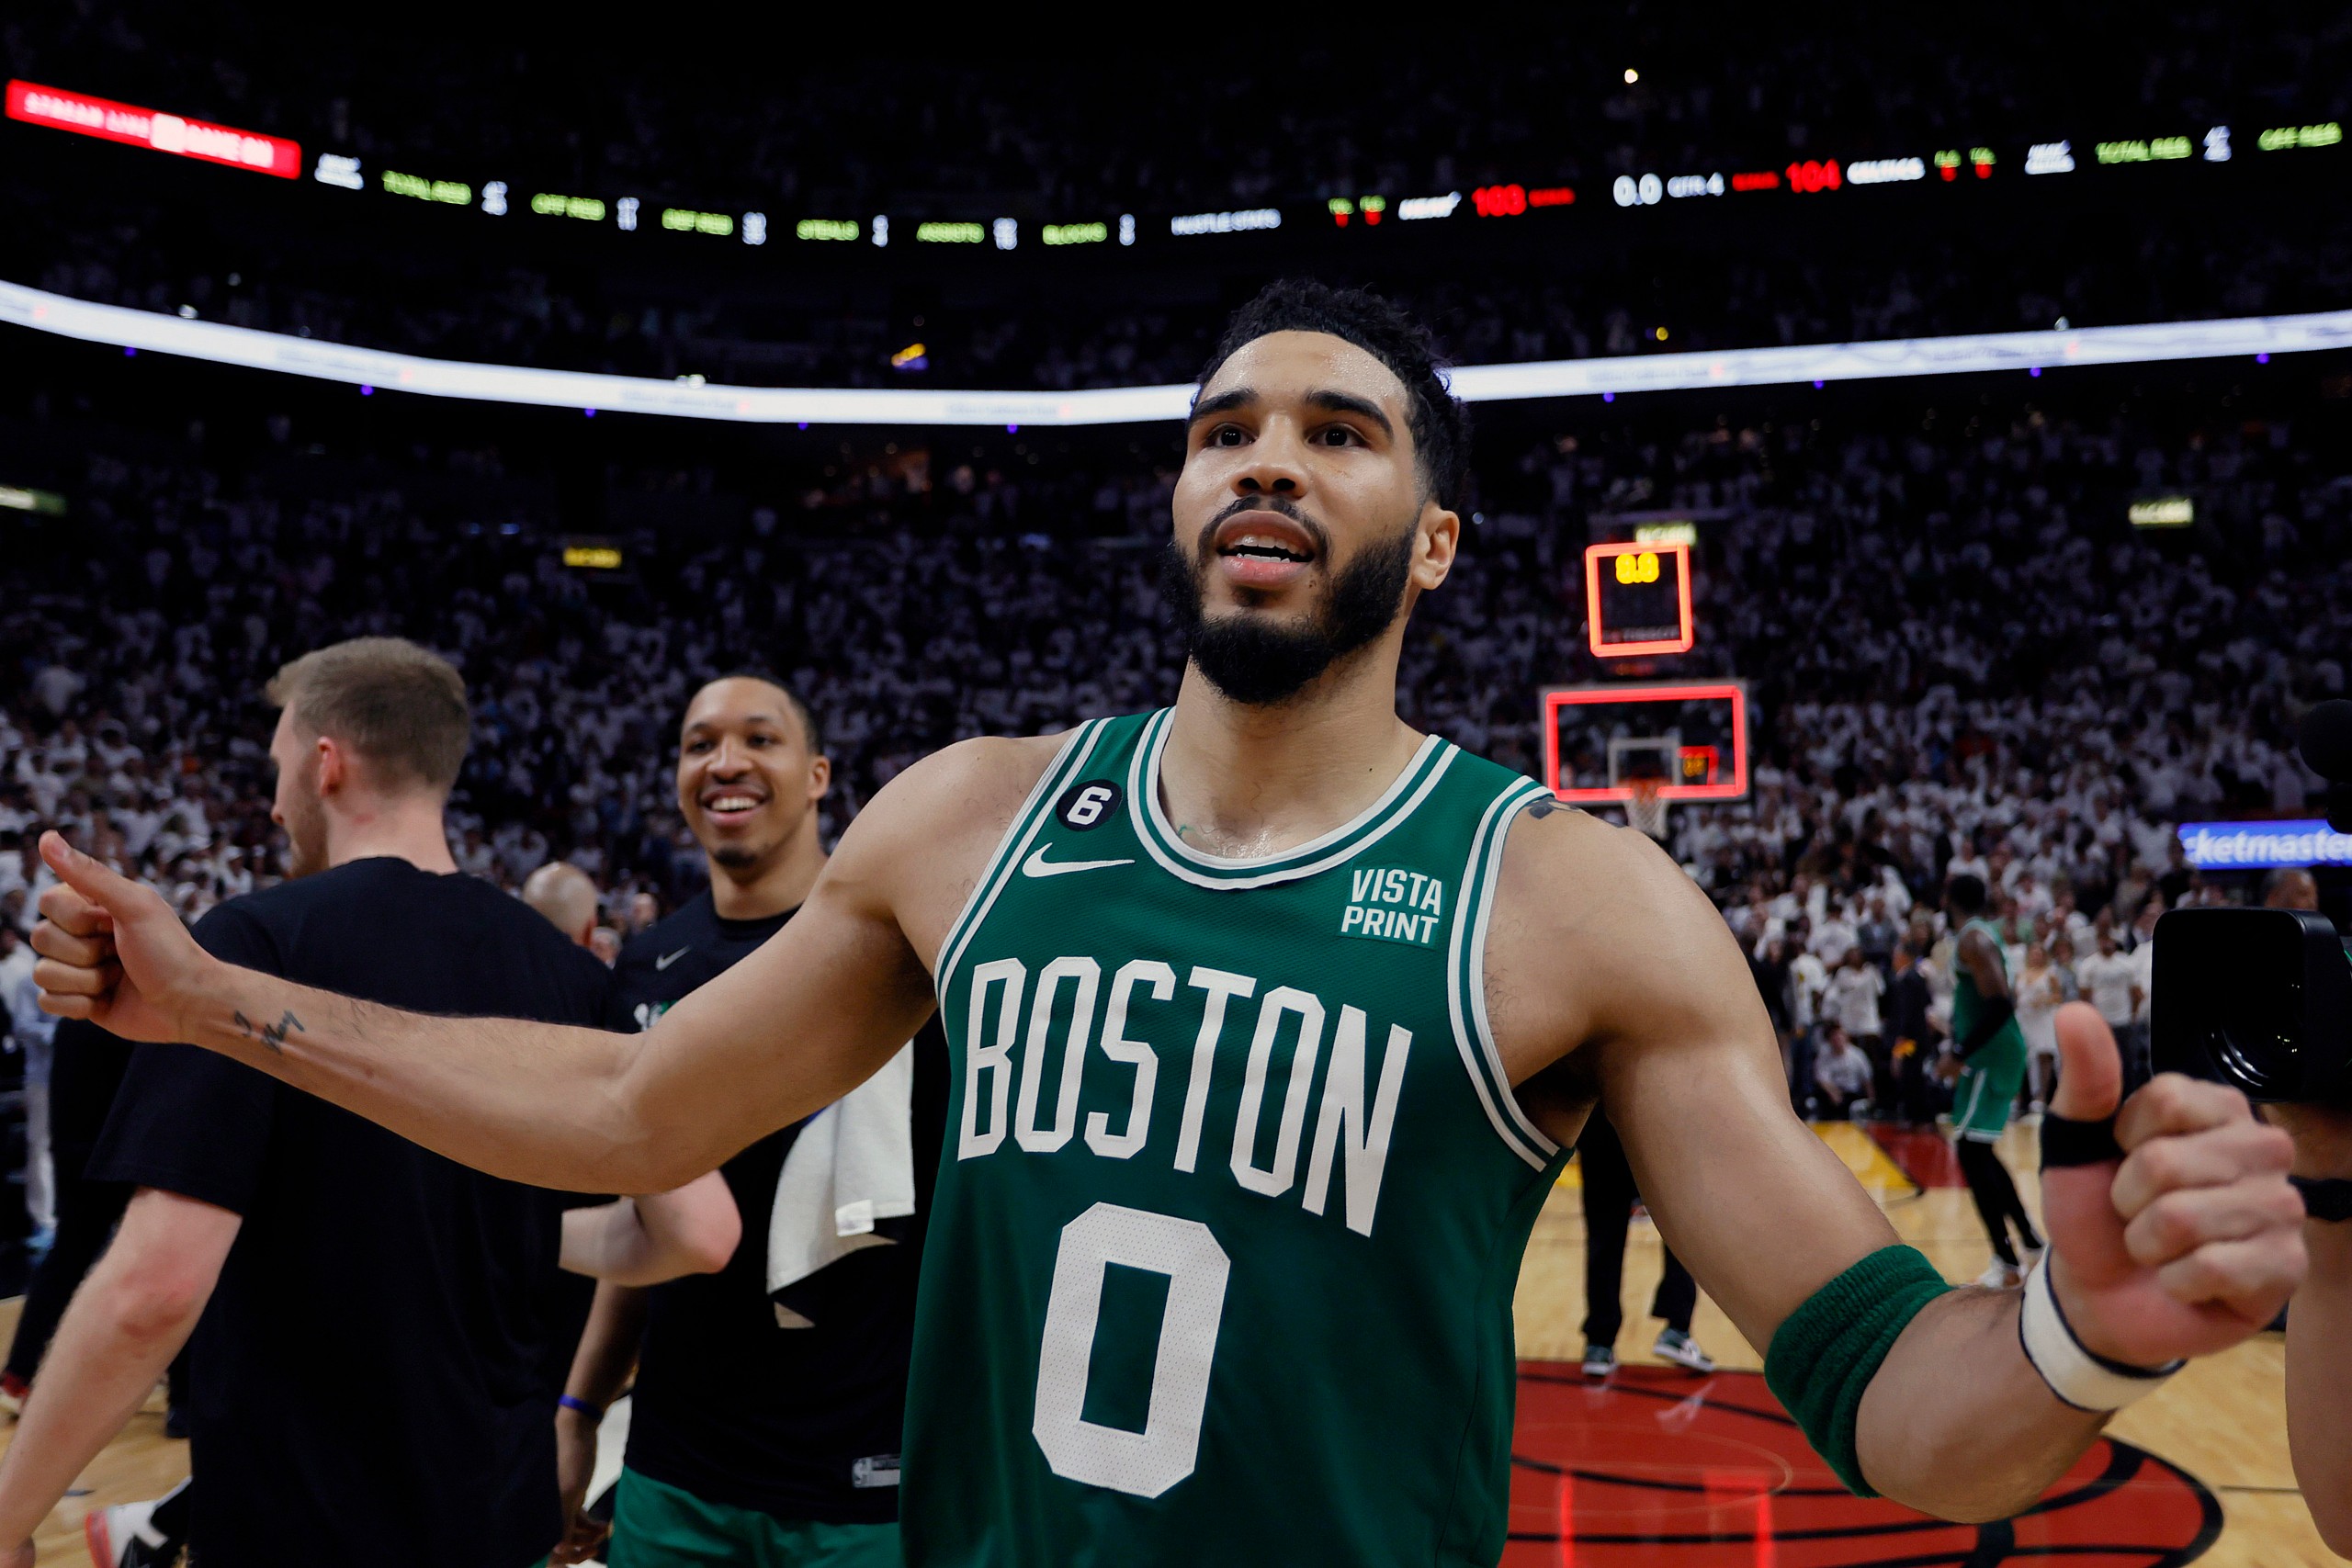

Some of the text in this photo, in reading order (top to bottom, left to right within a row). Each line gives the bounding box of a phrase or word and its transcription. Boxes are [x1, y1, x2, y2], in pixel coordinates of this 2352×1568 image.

[1067, 785, 1112, 825] 6
[1351, 868, 1442, 915] VISTA
[1341, 907, 1439, 943] PRINT
[957, 956, 1412, 1237] BOSTON
[1032, 1201, 1231, 1499] 0
